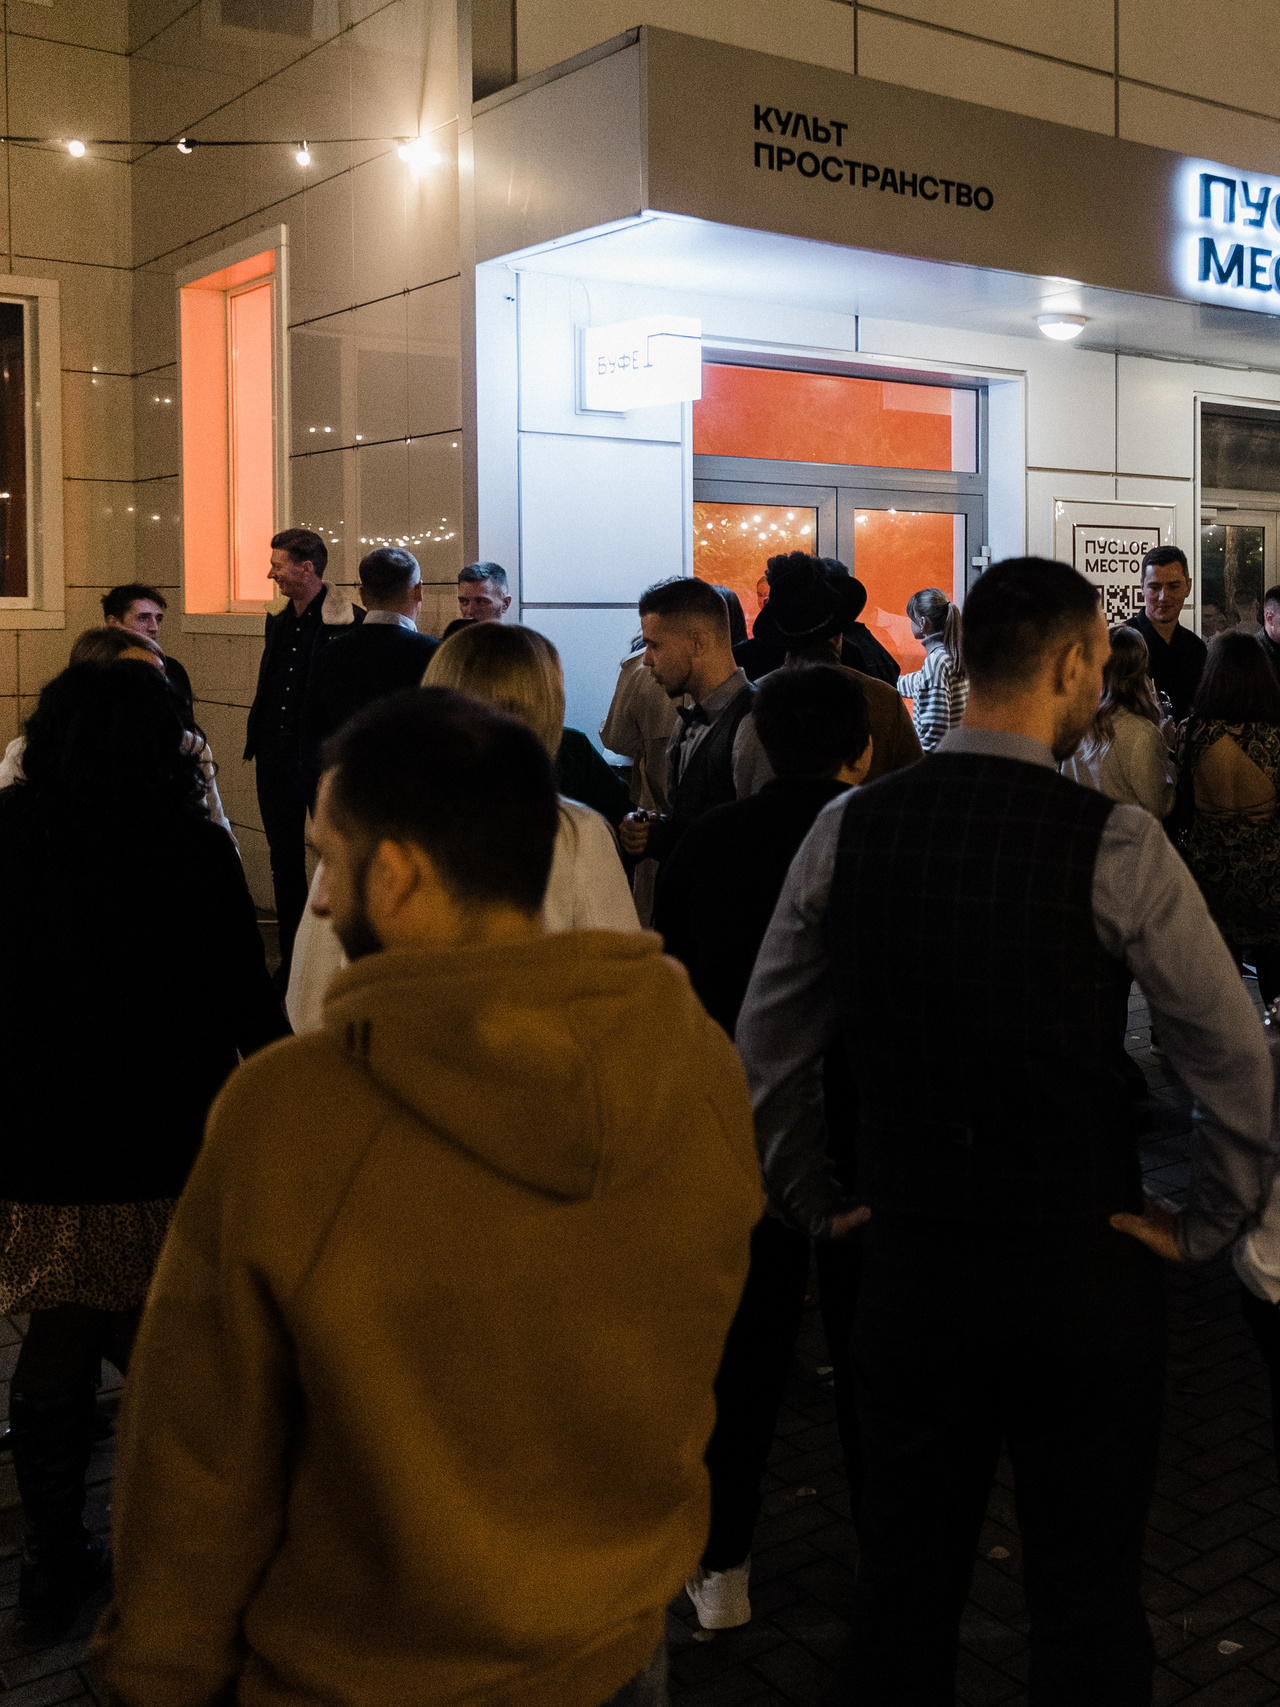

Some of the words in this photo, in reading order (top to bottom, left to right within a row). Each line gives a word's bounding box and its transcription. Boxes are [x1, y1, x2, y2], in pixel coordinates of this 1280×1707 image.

[753, 104, 848, 147] КУЛЬТ
[753, 141, 994, 211] ПРОСТРАНСТВО
[1085, 540, 1149, 555] ПУСТОЕ
[1085, 559, 1140, 573] МЕСТО
